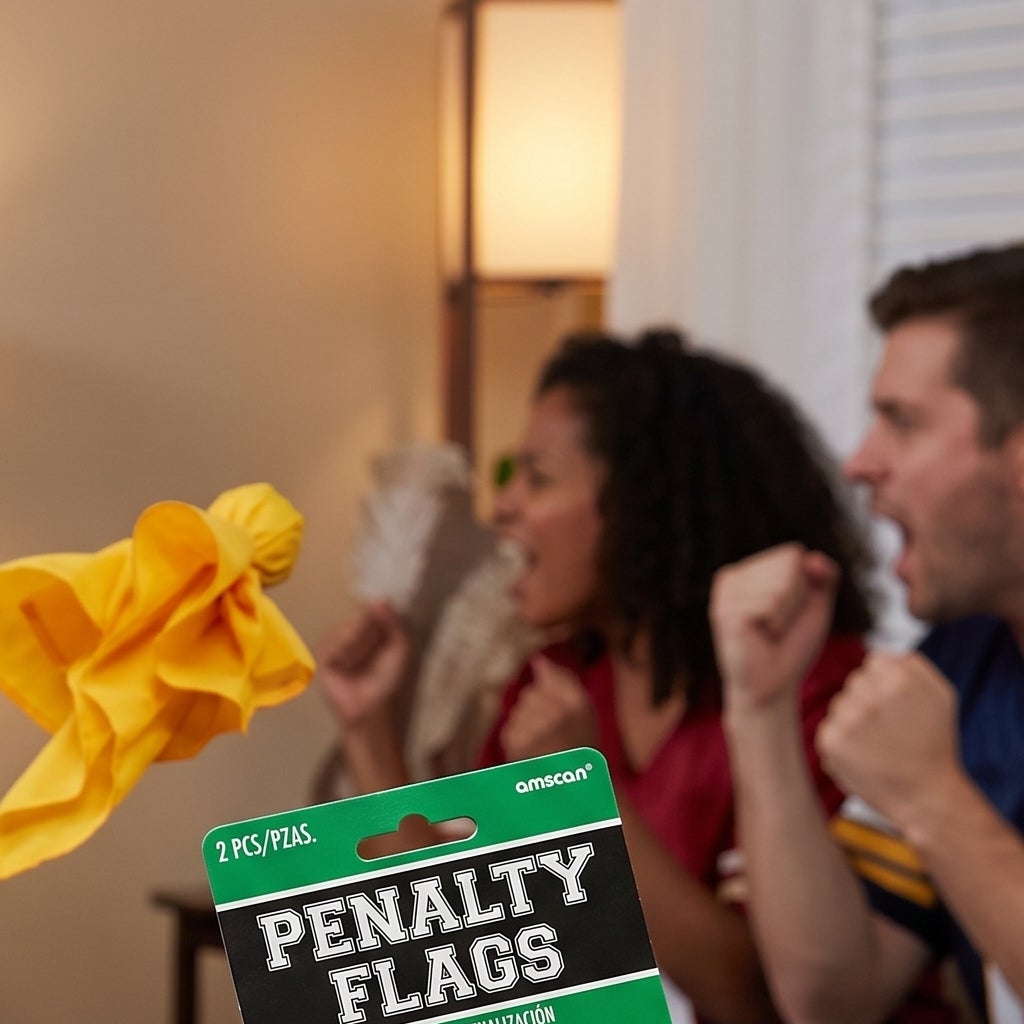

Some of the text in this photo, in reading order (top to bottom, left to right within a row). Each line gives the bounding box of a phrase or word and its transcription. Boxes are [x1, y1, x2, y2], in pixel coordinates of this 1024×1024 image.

[216, 822, 317, 863] 2 PCS/PZAS.
[256, 842, 594, 972] PENALTY
